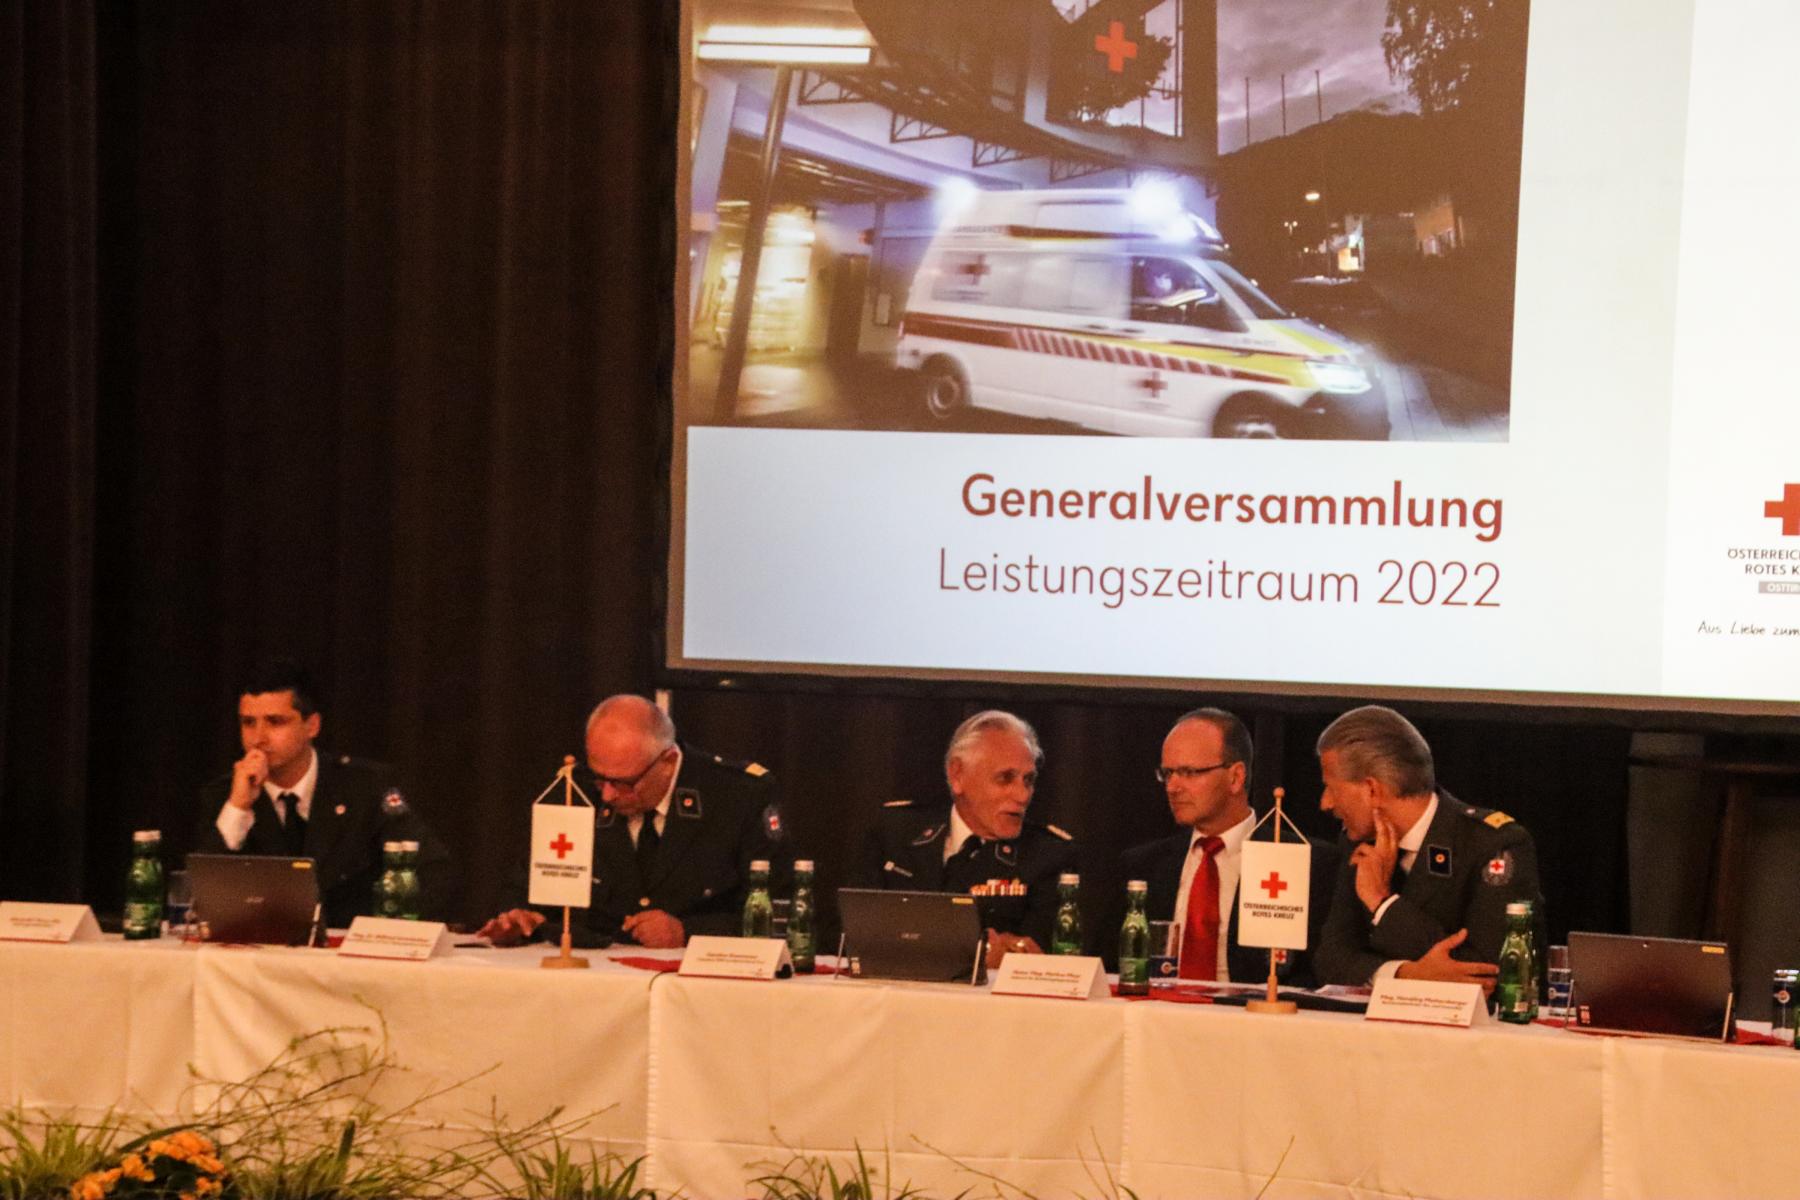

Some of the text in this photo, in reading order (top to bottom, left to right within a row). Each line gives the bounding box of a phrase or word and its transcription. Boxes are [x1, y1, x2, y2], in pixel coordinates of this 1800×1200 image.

[961, 472, 1504, 543] Generalversammlung
[1727, 548, 1800, 560] ÖSTERREIC
[939, 546, 1501, 609] Leistungszeitraum 2022
[1744, 564, 1787, 576] ROTES
[1698, 620, 1722, 635] Aus
[1730, 620, 1766, 636] Liebe
